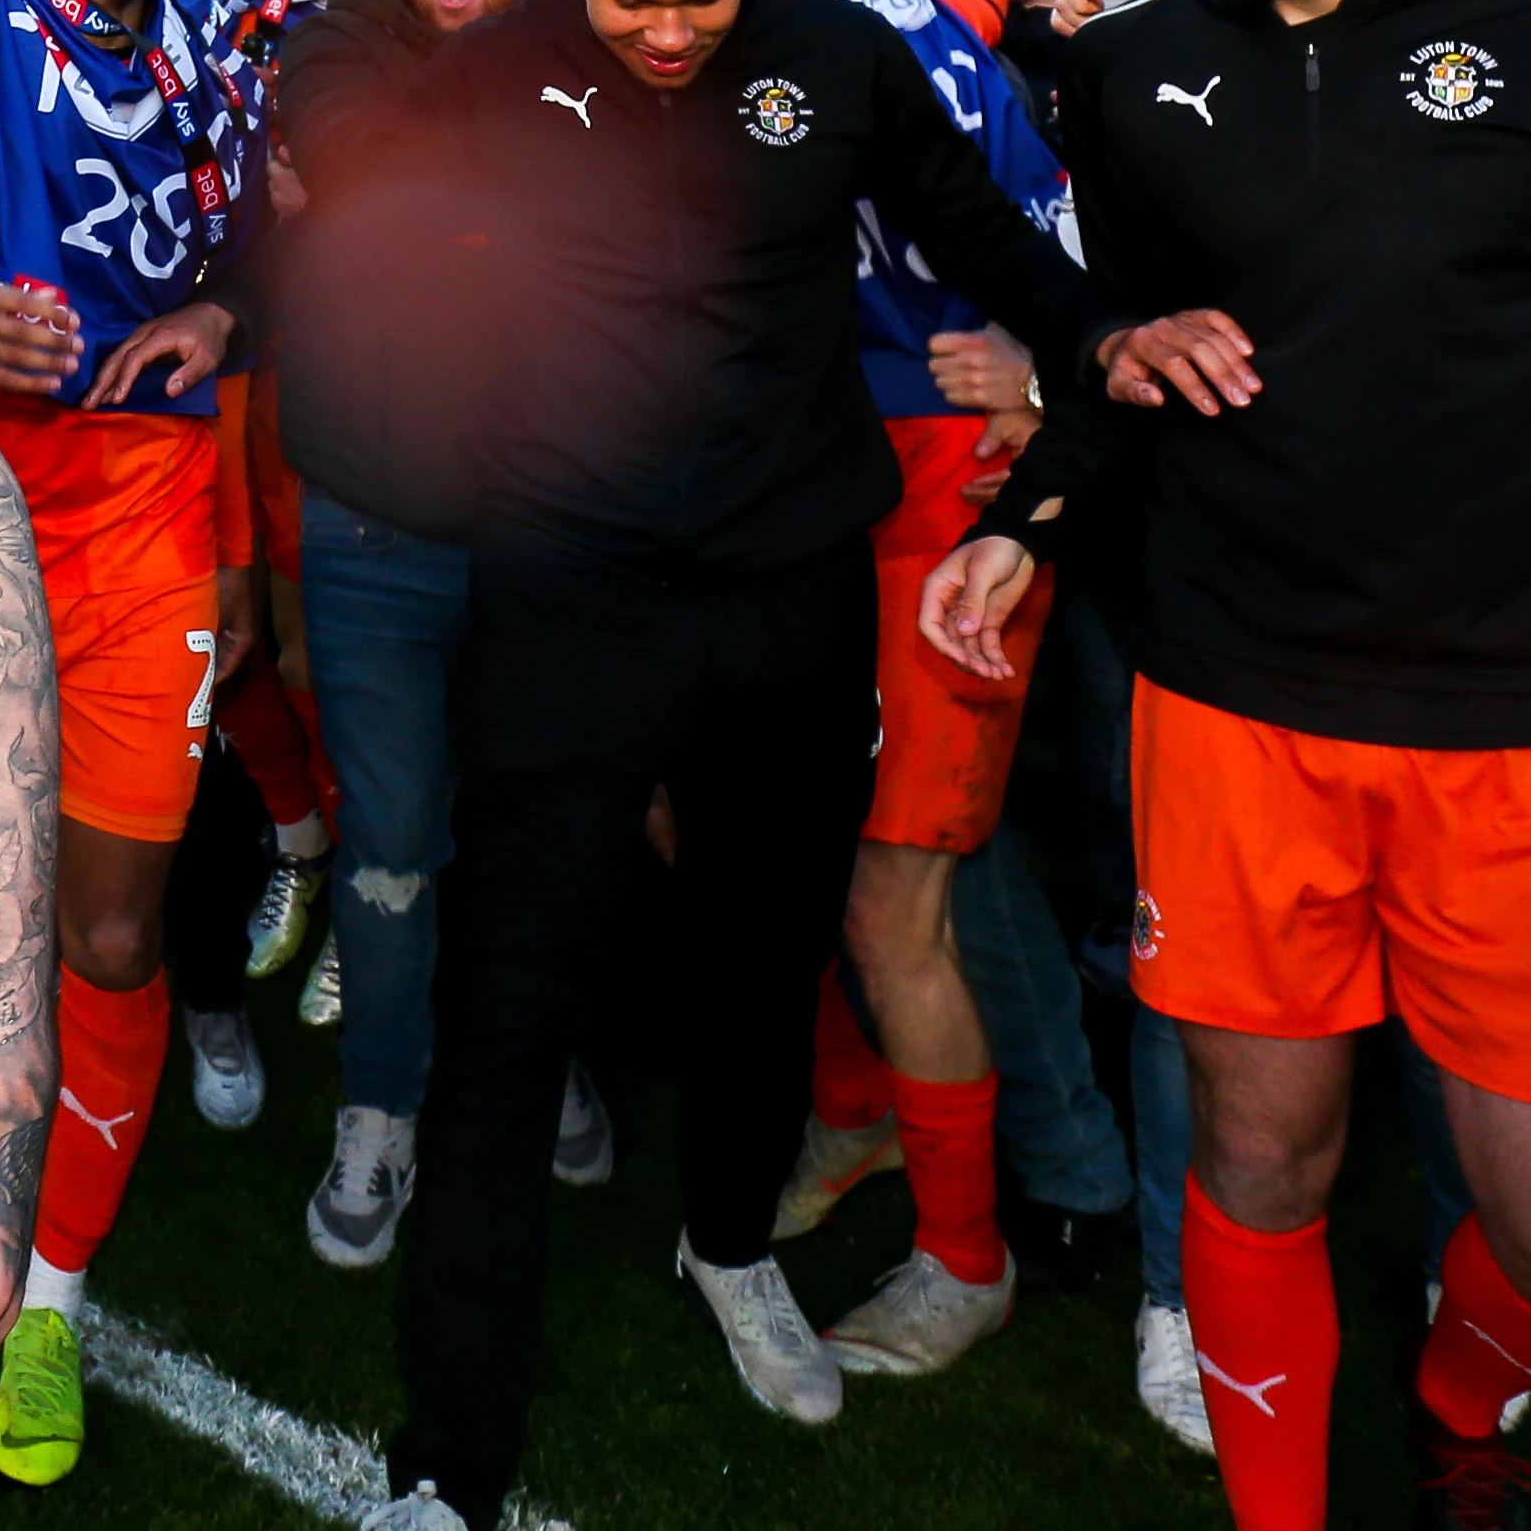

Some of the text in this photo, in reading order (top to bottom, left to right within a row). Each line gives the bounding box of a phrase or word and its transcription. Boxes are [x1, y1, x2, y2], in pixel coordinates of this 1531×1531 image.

[1409, 40, 1499, 71] LUTON TOWN
[151, 53, 179, 99] bet
[742, 77, 807, 102] LUTON TOWN
[173, 101, 196, 138] sky
[1405, 89, 1465, 122] FOOTBALL
[745, 122, 791, 146] FOOTBALL
[195, 167, 219, 211] bet
